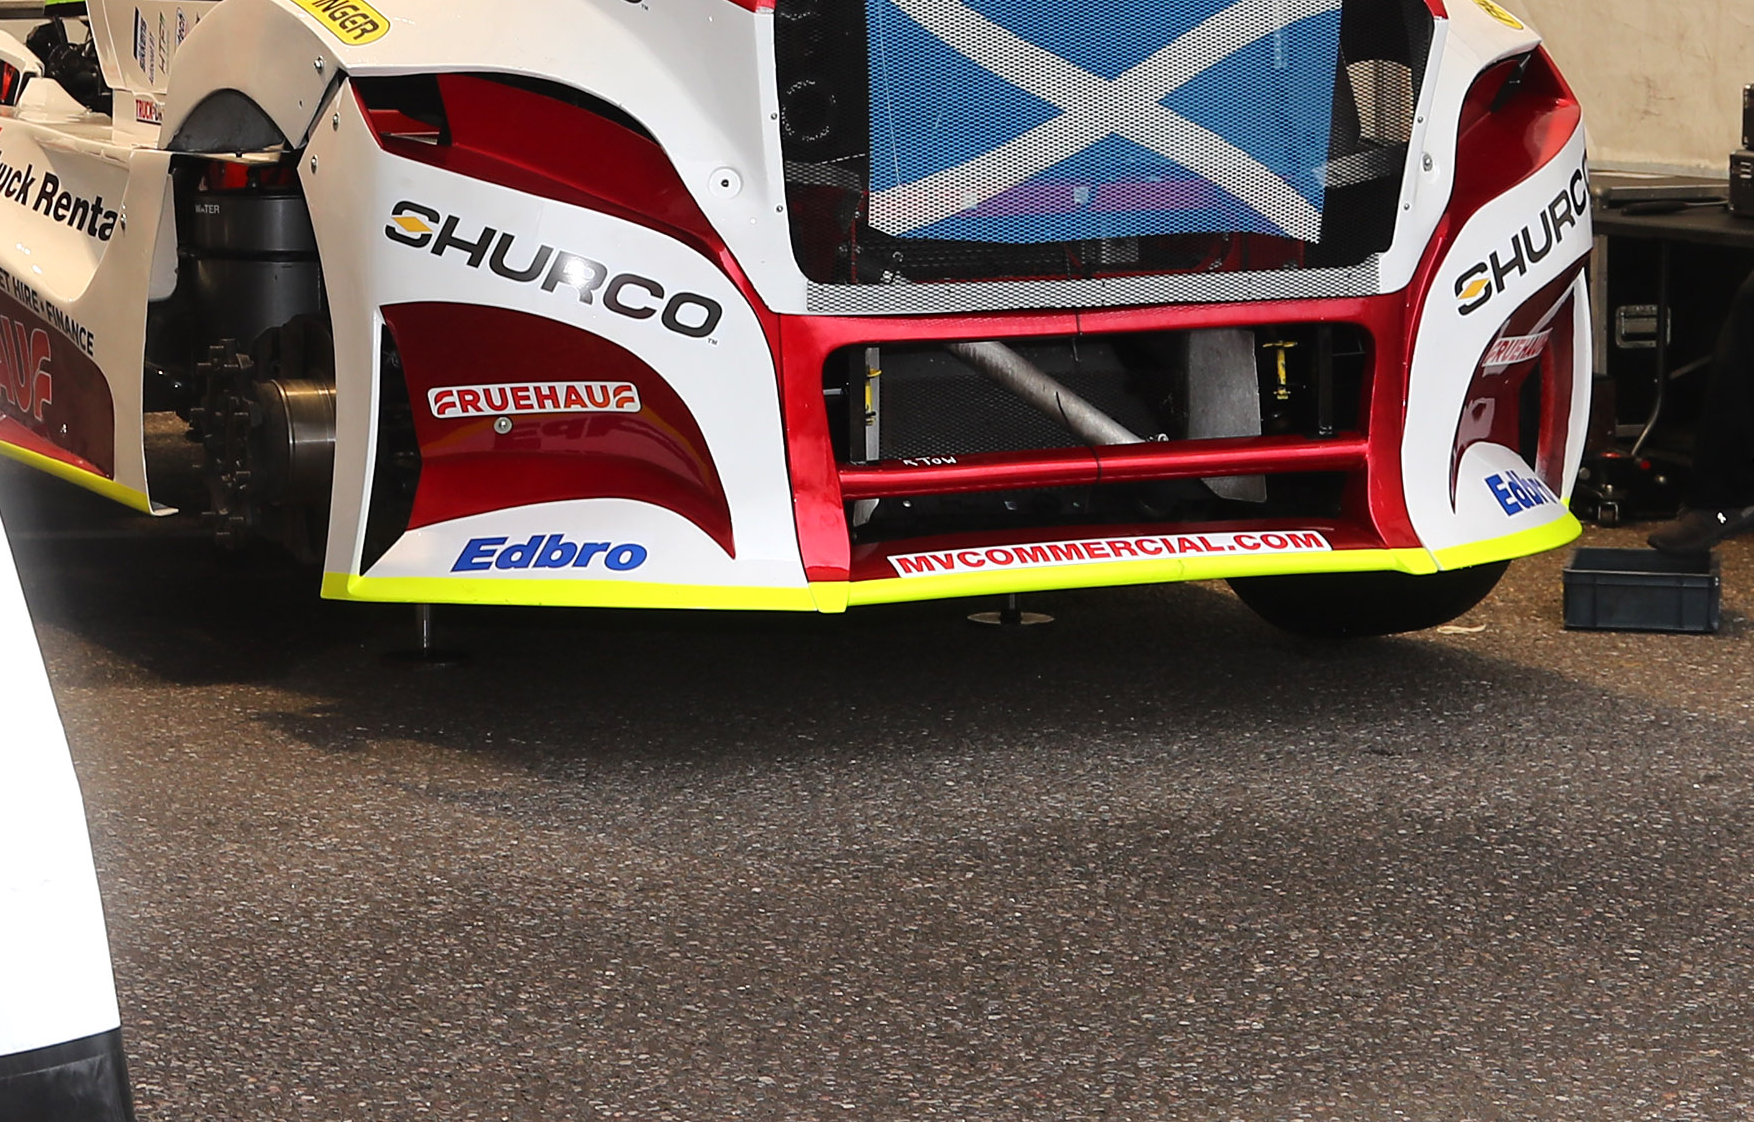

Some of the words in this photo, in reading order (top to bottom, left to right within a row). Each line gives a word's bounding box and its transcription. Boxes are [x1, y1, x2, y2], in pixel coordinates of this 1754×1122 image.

[385, 200, 723, 338] SHURCO
[12, 276, 40, 314] HIRE
[45, 301, 95, 358] FINANCE
[434, 384, 636, 415] FRUEHAUF
[450, 533, 648, 572] Edbro
[895, 531, 1325, 575] MVCOMMERCIAL.COM
